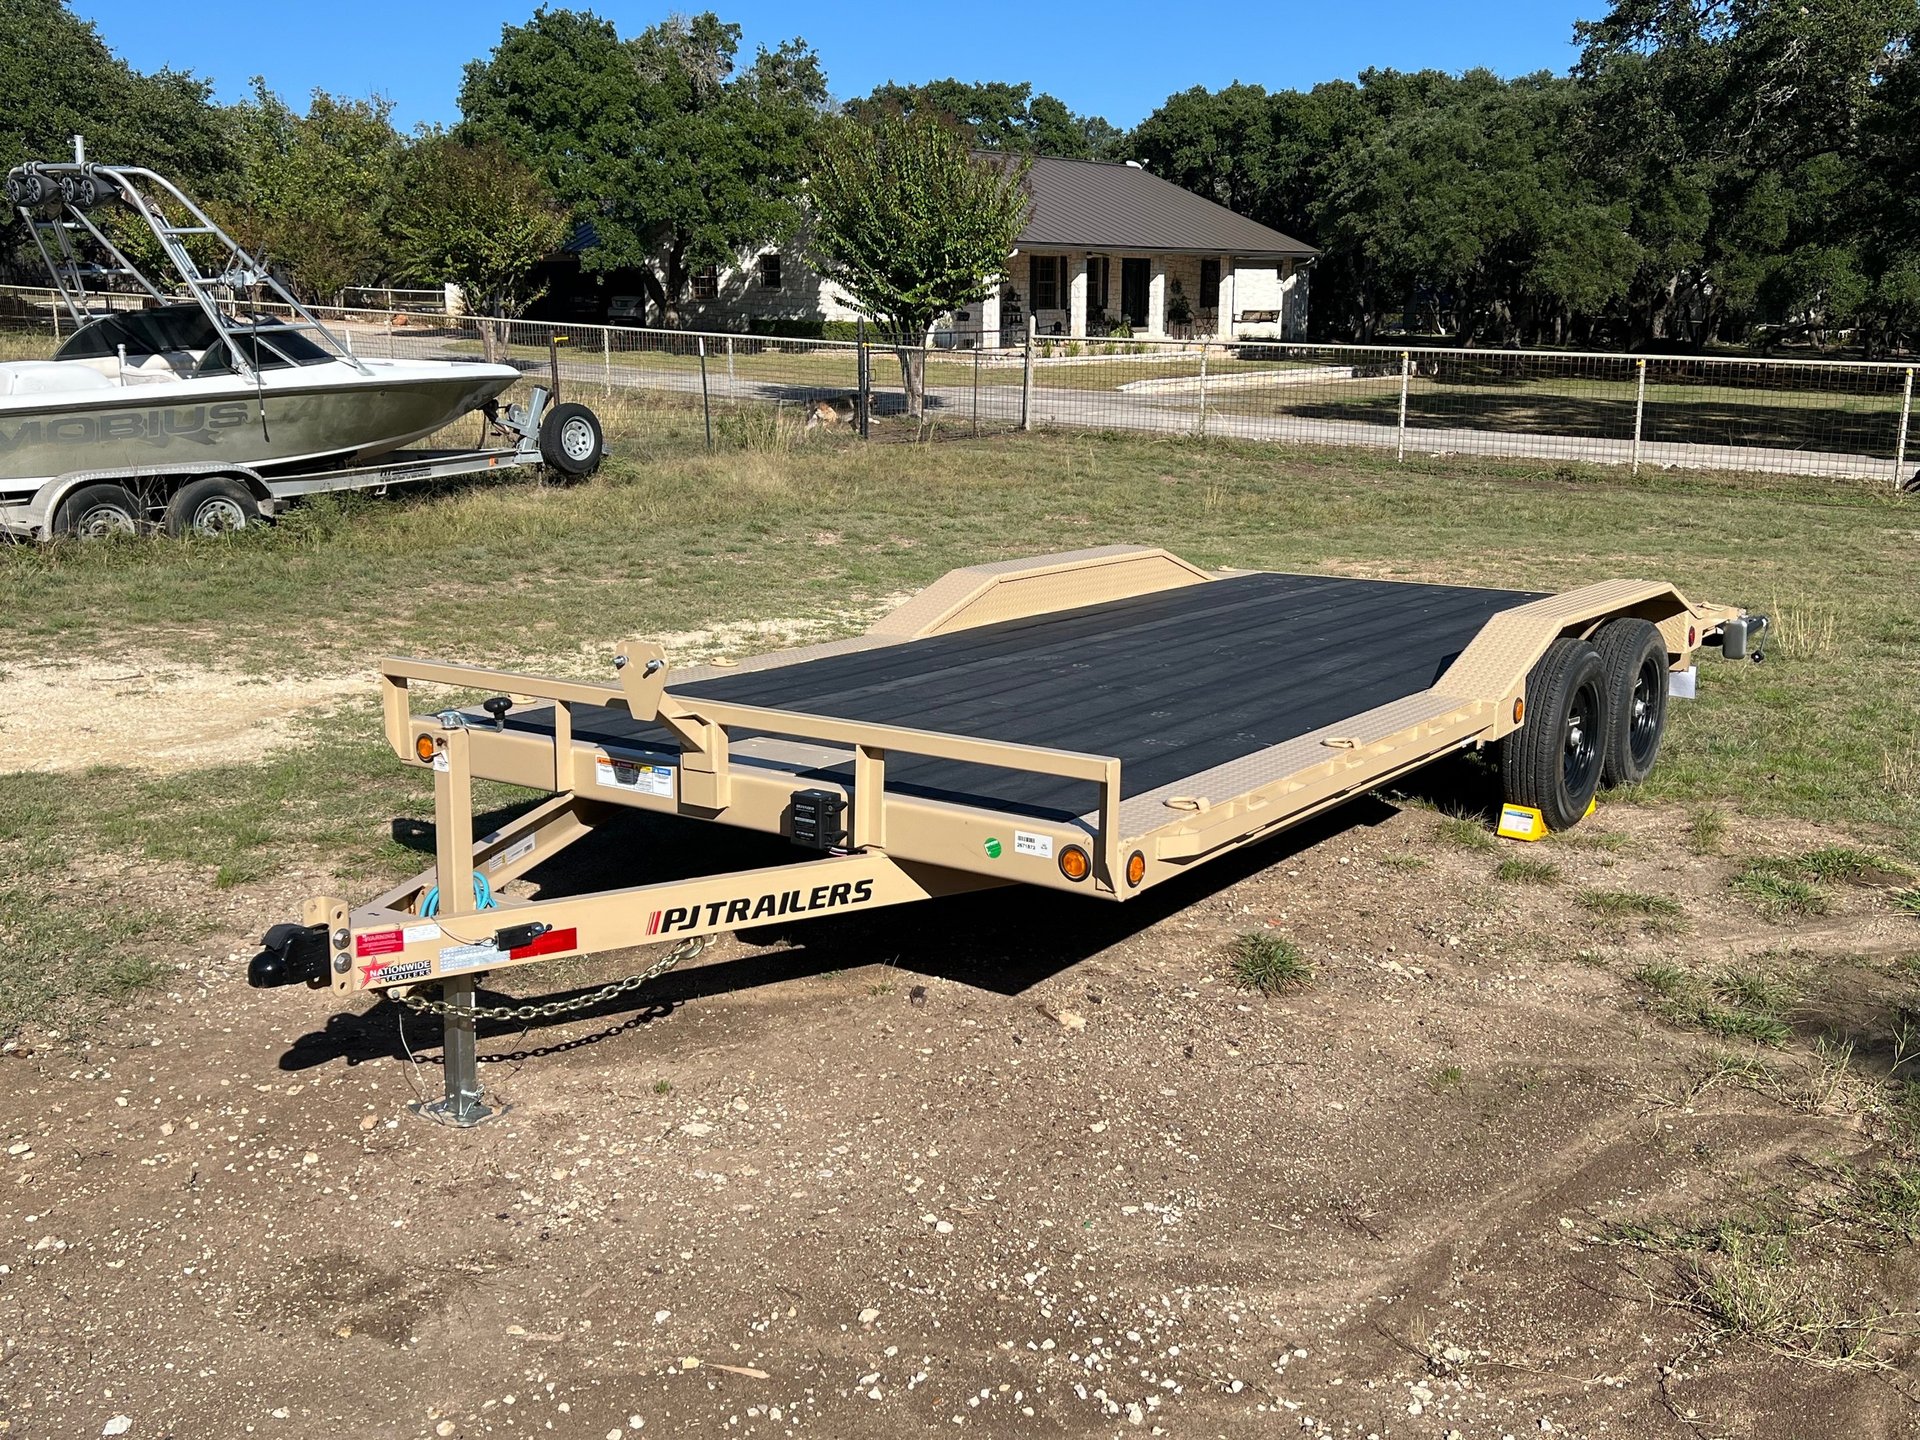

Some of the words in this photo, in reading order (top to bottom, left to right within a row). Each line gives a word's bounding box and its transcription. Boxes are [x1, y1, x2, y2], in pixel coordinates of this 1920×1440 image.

[661, 905, 701, 933] PJ
[705, 879, 874, 926] TRAILERS
[365, 932, 396, 942] WARNING
[369, 960, 431, 977] NATIONWIDE
[385, 969, 431, 982] TRAILERS
